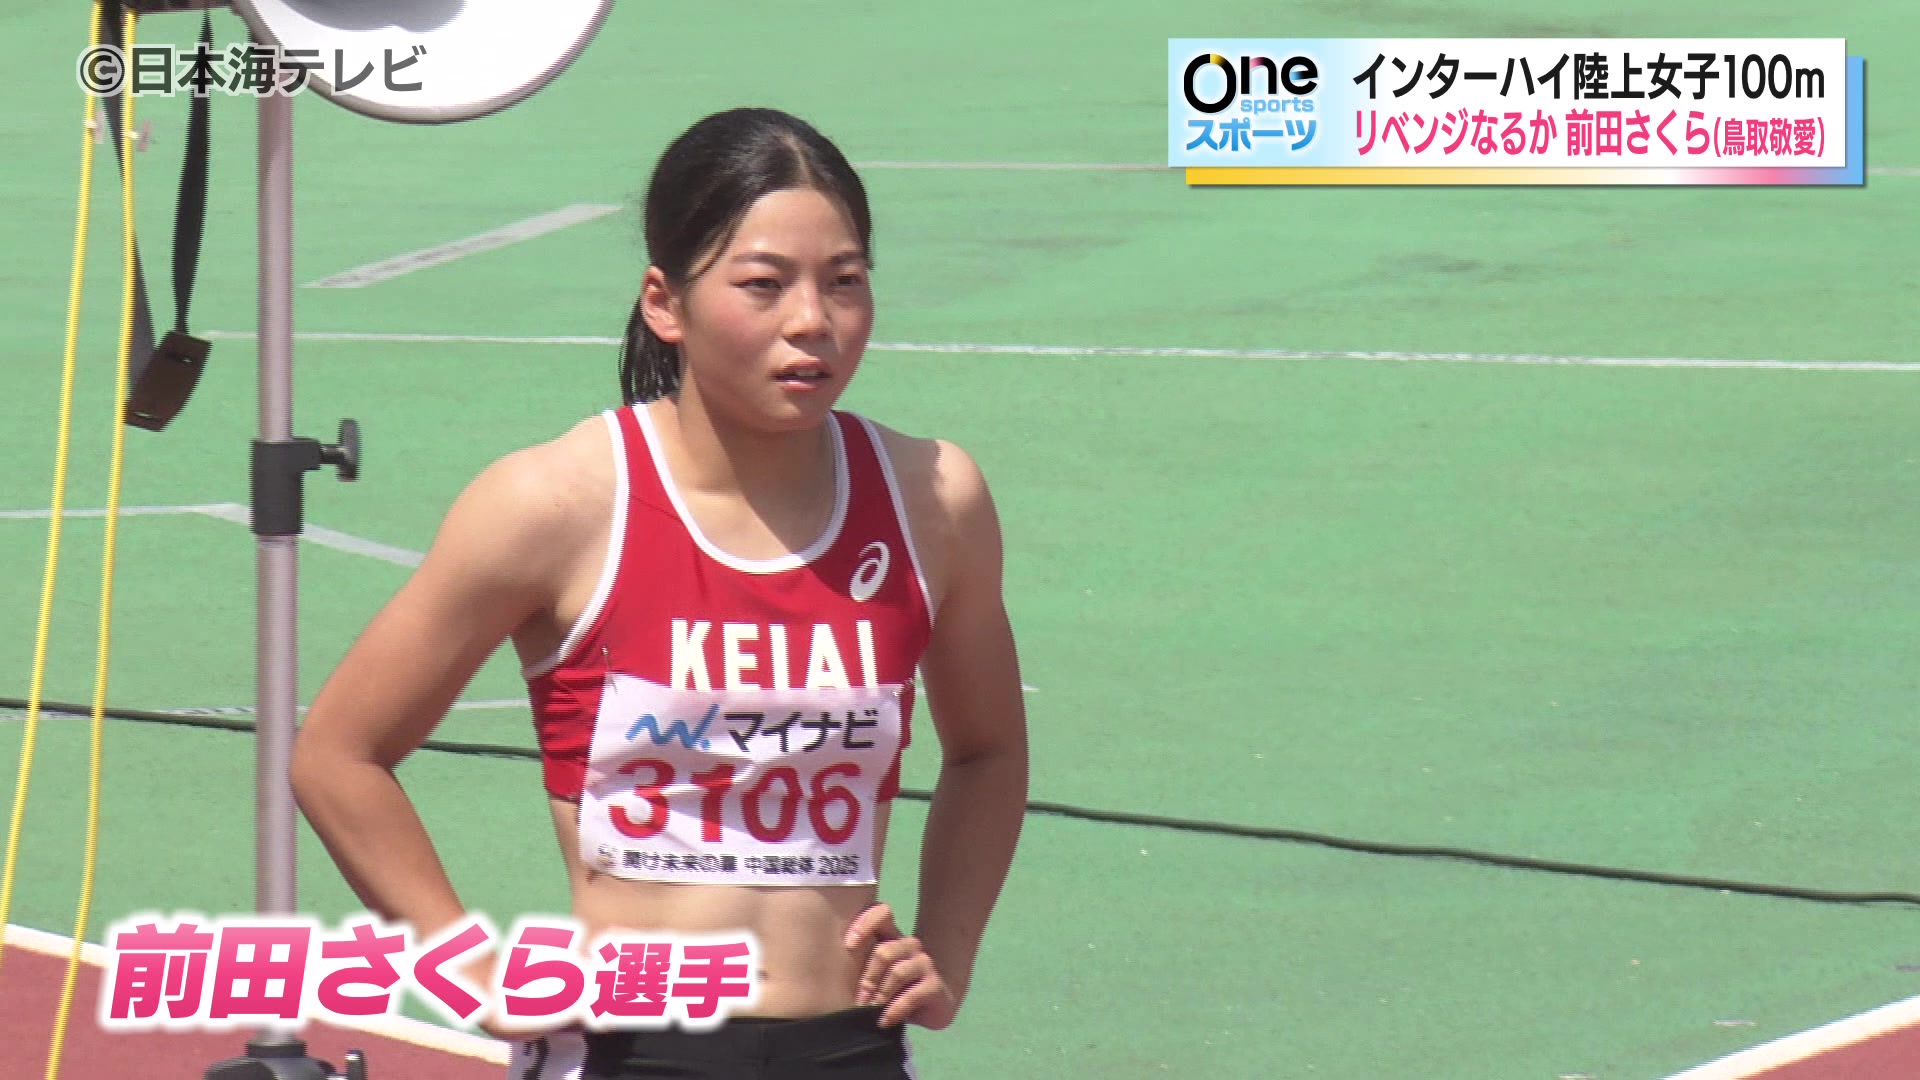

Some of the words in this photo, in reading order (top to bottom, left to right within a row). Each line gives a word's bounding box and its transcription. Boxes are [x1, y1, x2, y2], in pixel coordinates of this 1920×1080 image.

[671, 618, 880, 693] KEIAI
[724, 709, 879, 752] マイナビ
[608, 758, 863, 846] 3106
[744, 855, 815, 875] 中国総体
[817, 854, 859, 875] 2025
